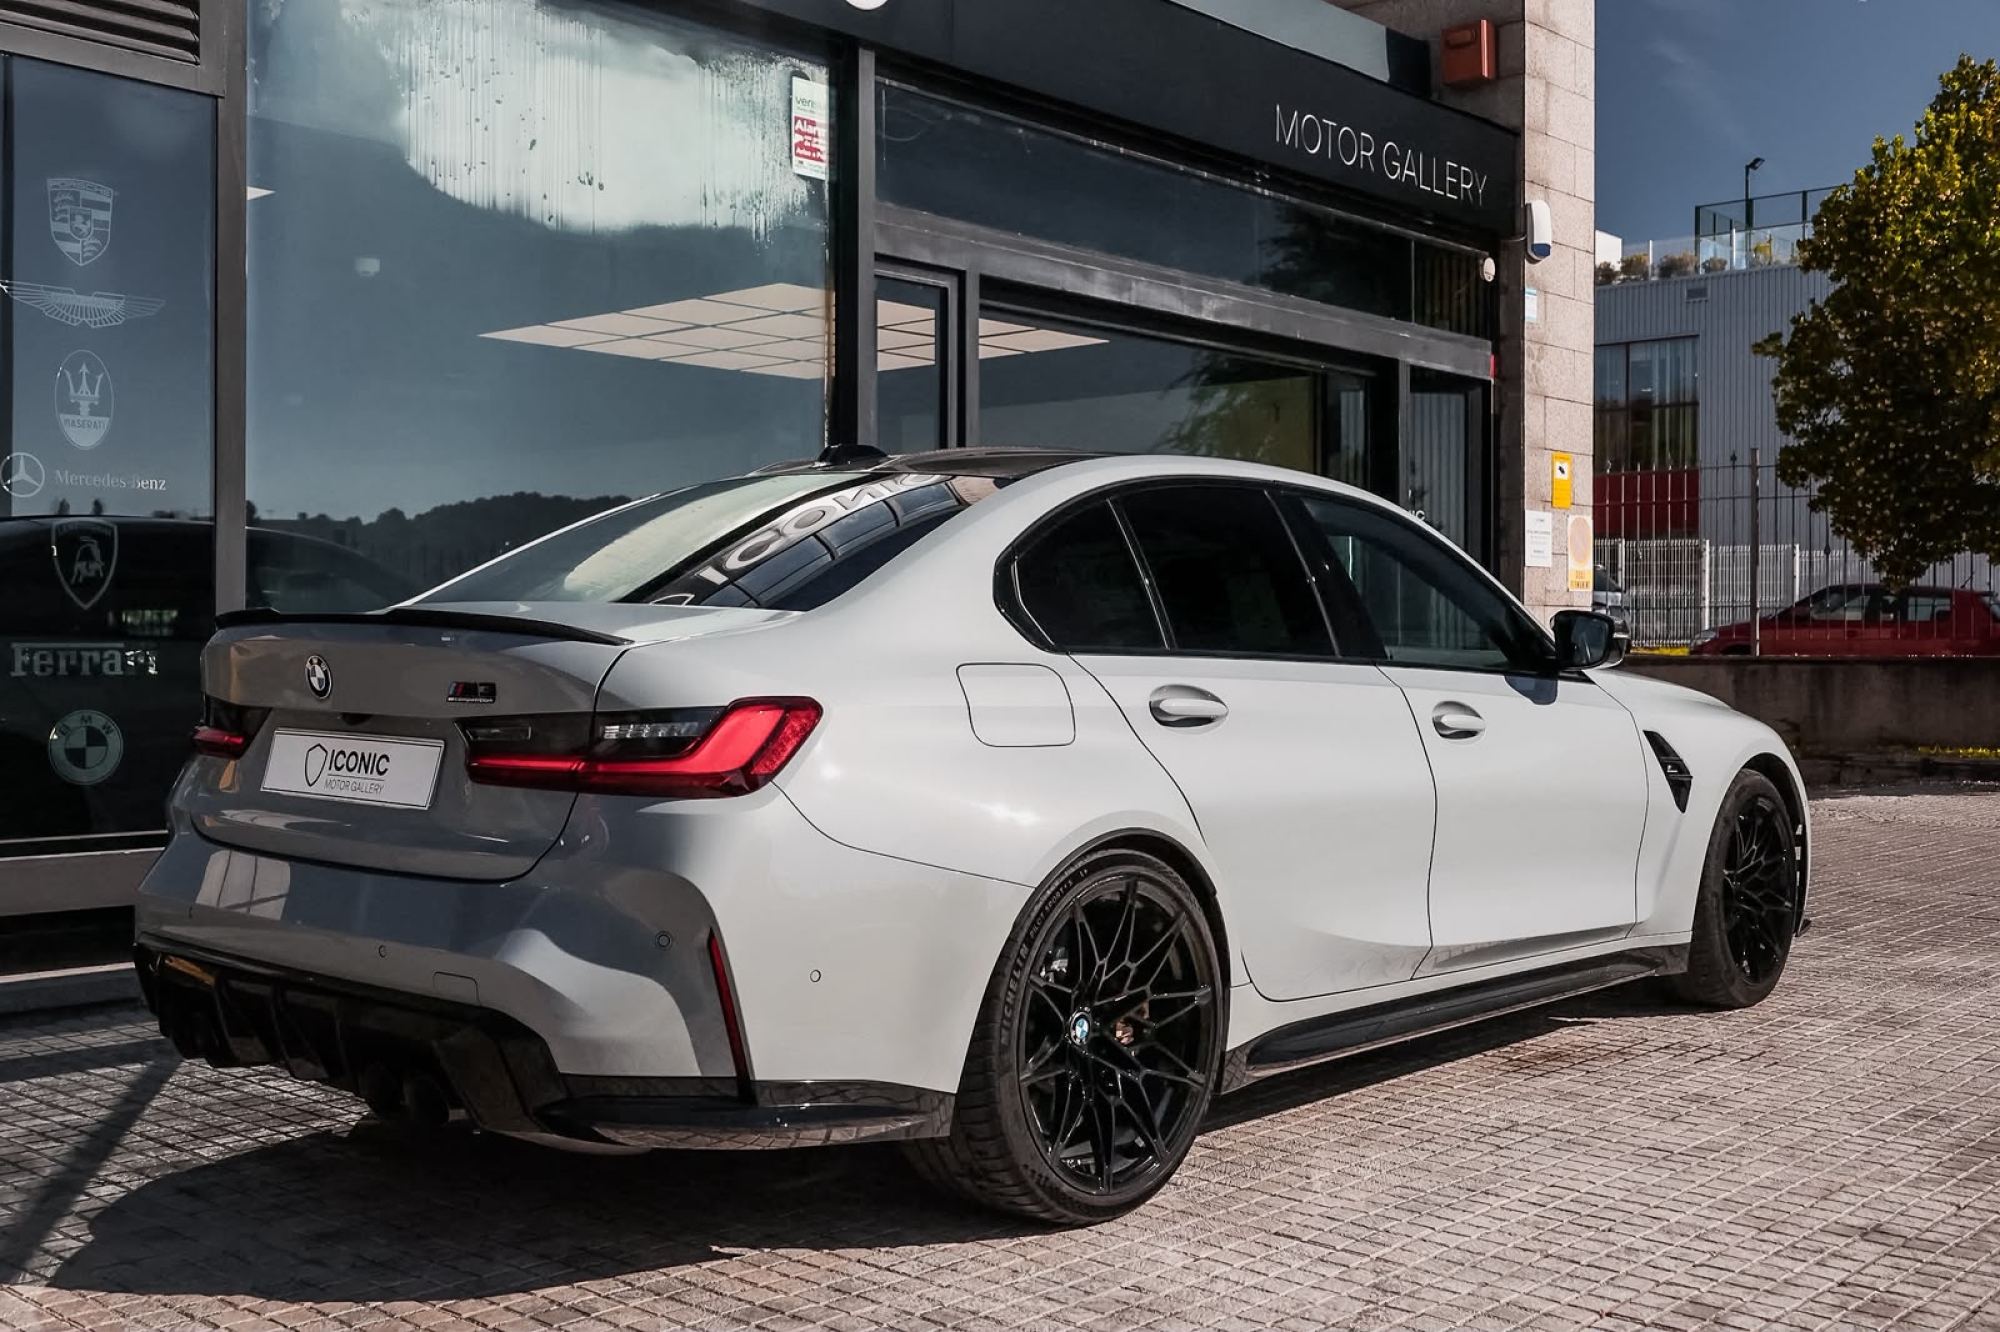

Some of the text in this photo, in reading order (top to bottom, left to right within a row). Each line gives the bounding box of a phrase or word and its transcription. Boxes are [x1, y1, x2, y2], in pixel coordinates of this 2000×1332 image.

[1275, 103, 1487, 207] MOTOR GALLERY
[63, 418, 107, 430] MASERATI
[55, 470, 167, 491] Mercedes-Benz
[328, 749, 390, 777] ICONIC
[323, 778, 385, 795] MOTOR GALLERY
[1001, 943, 1027, 1047] MICHELIN
